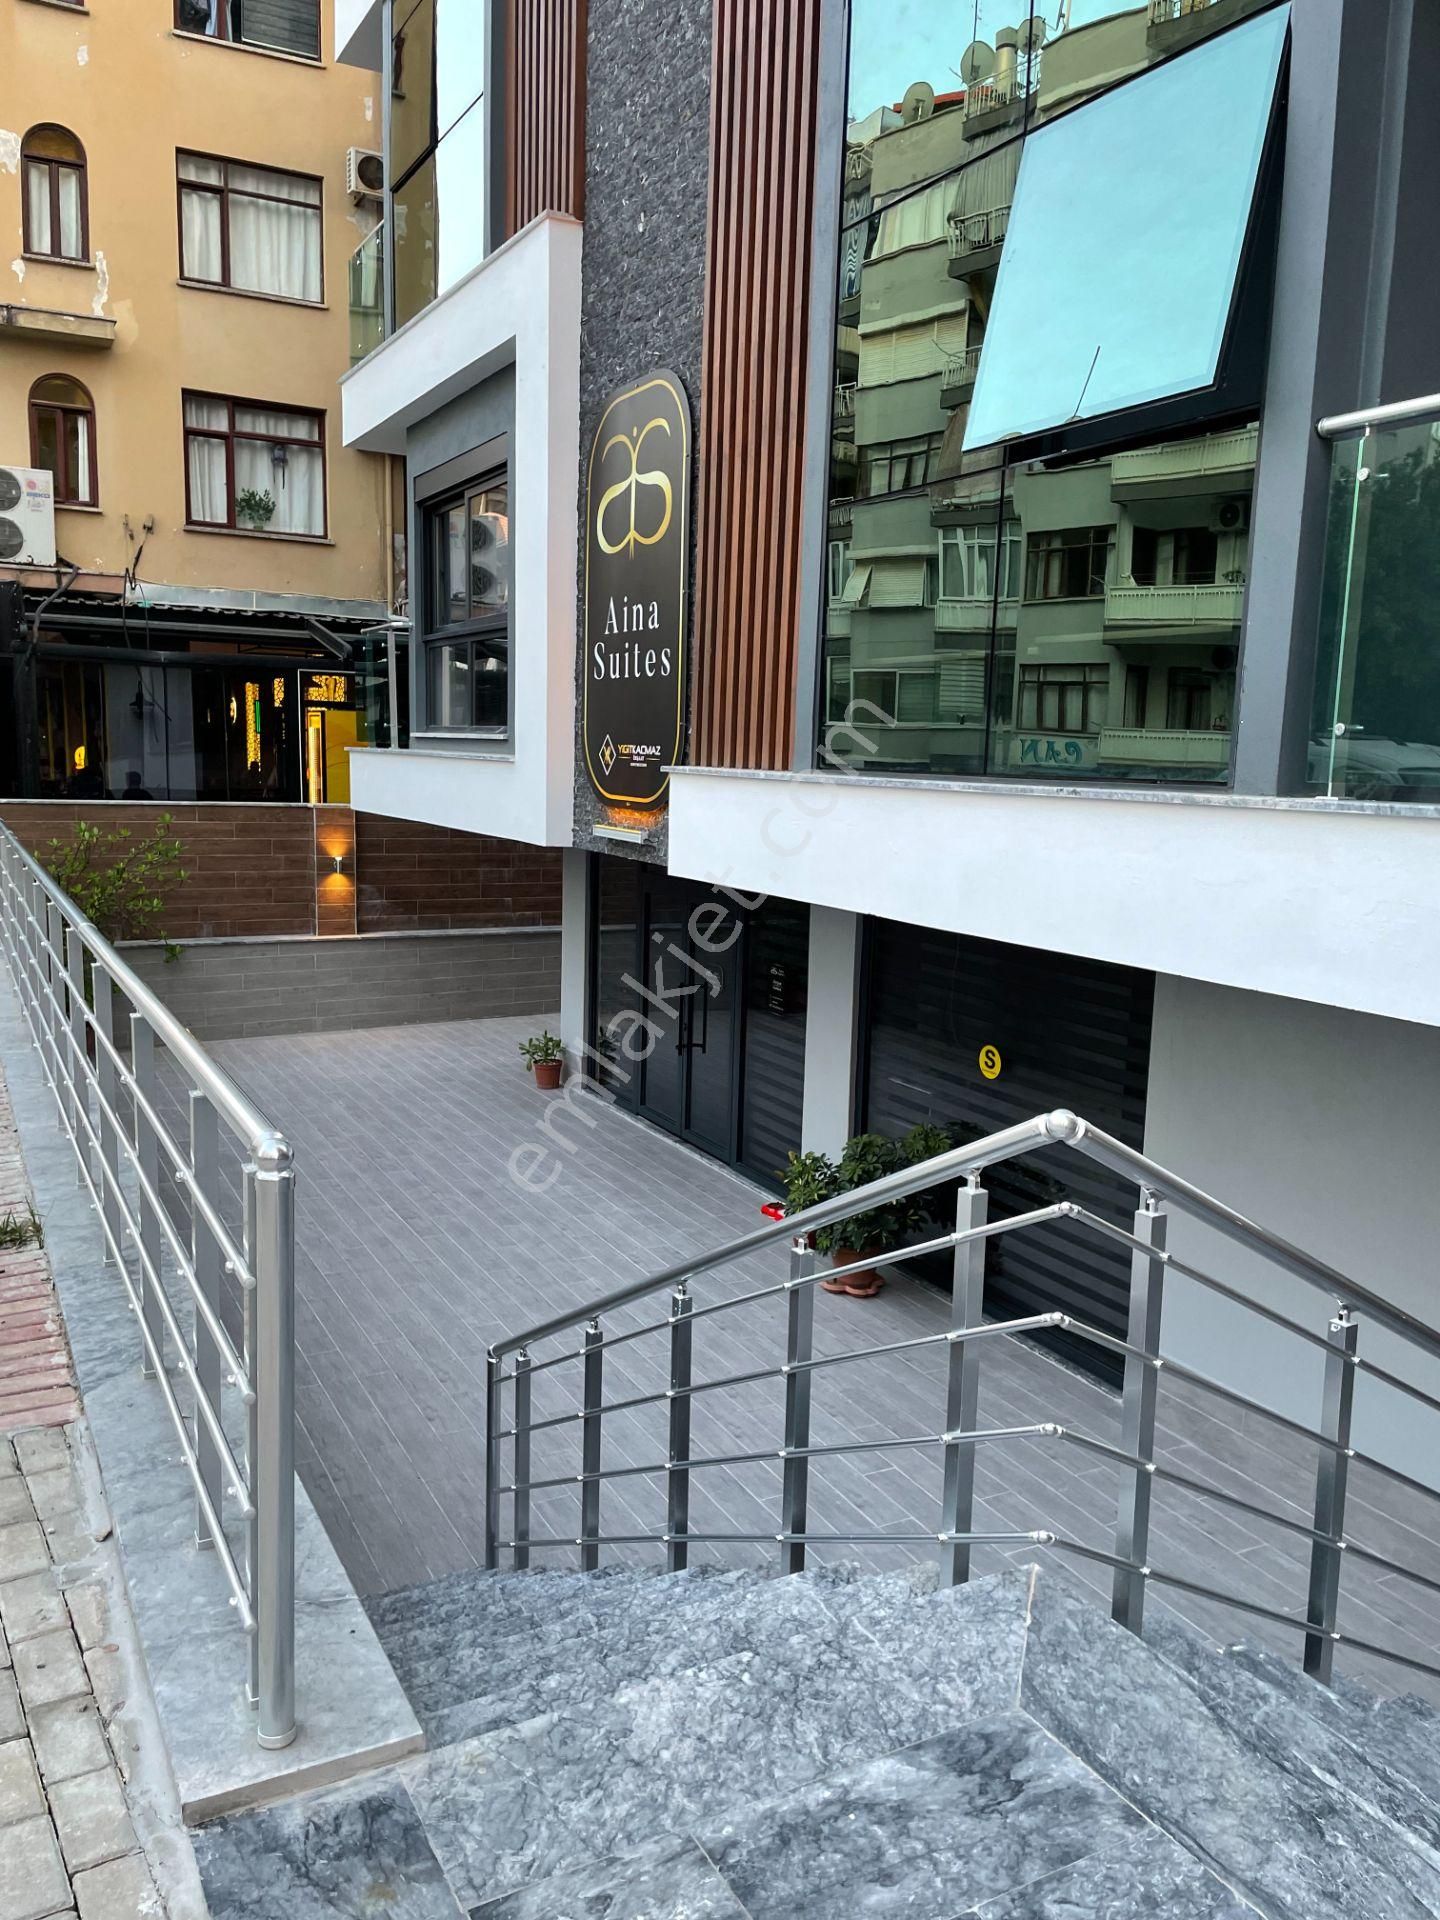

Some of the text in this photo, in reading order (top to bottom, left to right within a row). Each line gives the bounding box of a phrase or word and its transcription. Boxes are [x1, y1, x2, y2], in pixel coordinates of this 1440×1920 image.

[604, 595, 660, 635] Aina
[593, 641, 671, 680] Suites
[984, 1049, 996, 1070] S
